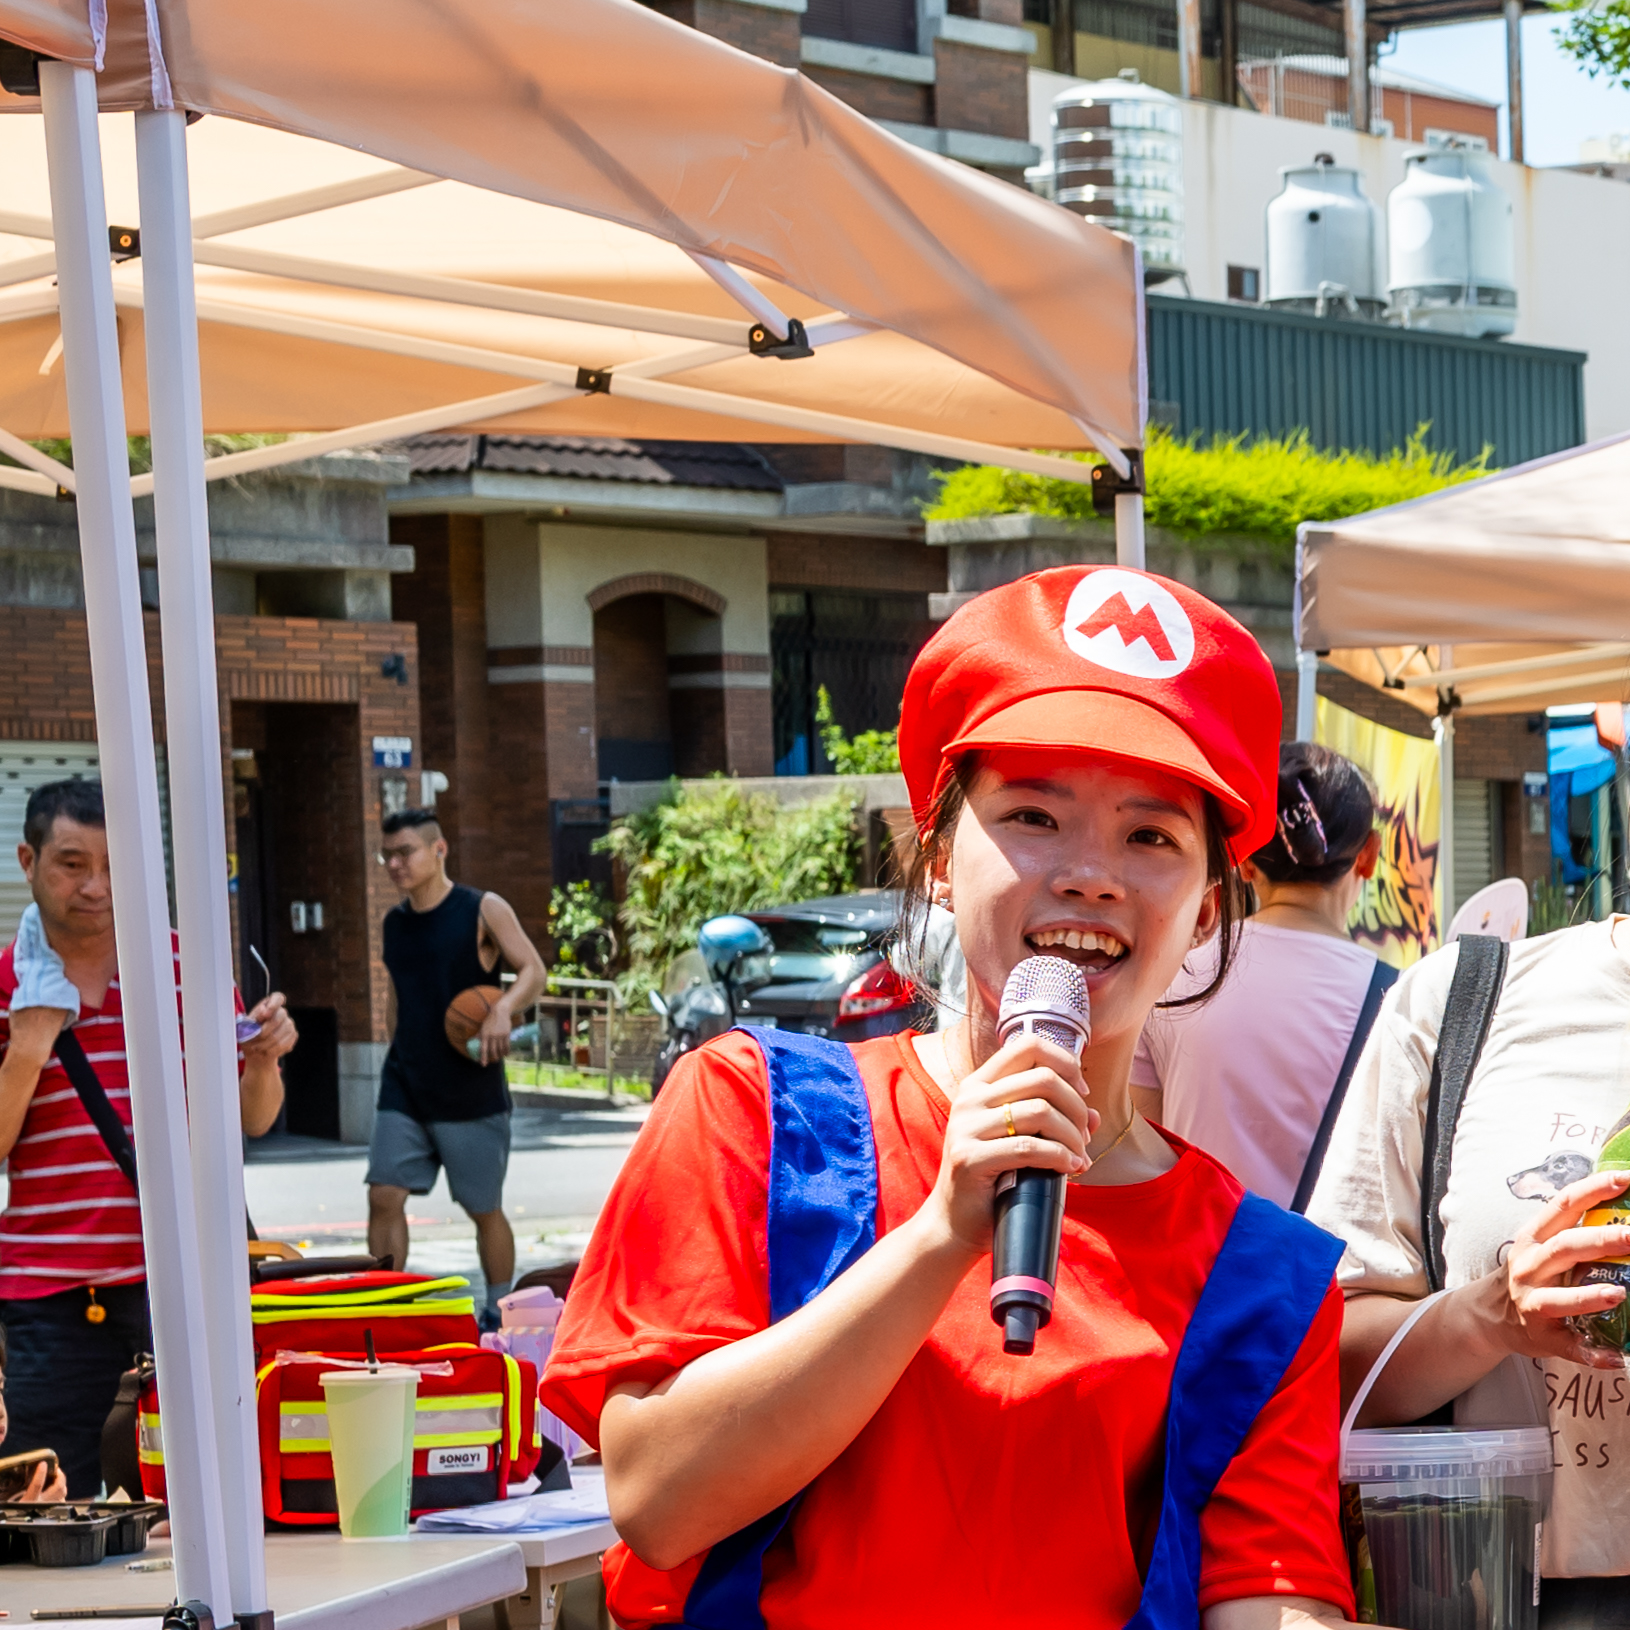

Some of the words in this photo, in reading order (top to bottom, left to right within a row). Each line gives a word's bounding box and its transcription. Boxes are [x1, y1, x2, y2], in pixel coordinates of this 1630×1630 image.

[1075, 590, 1177, 662] M
[1588, 1265, 1627, 1283] BRUT
[439, 1452, 480, 1464] SONGYI
